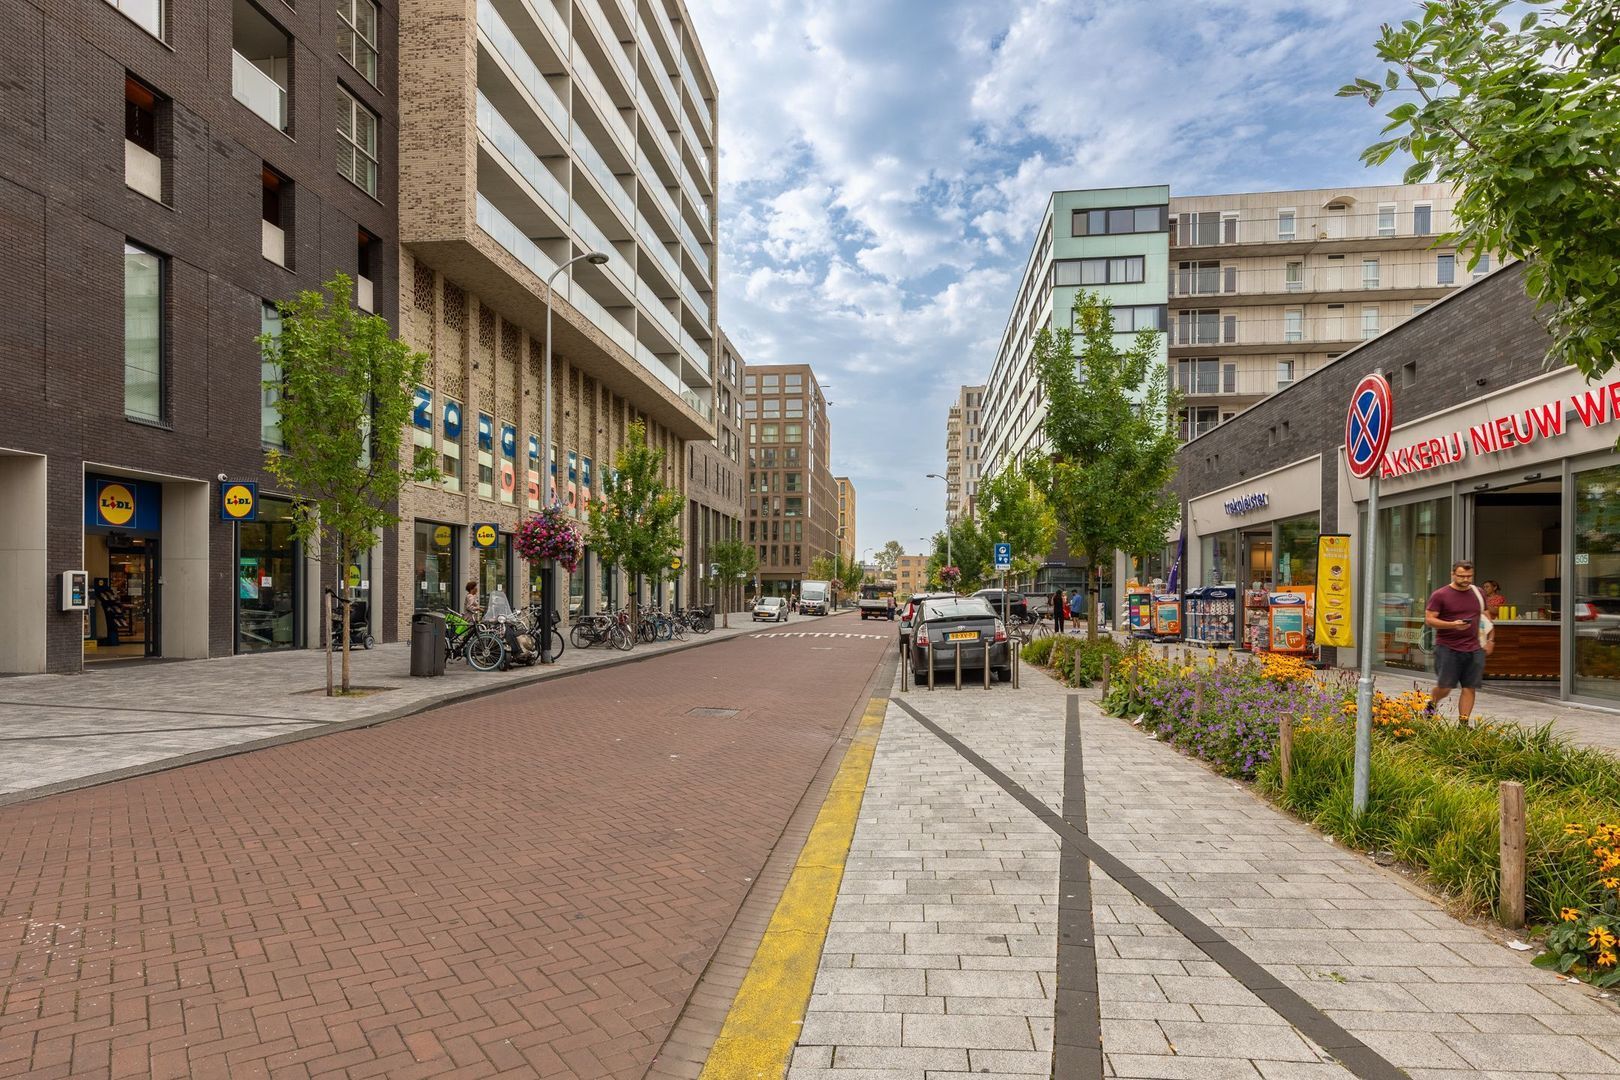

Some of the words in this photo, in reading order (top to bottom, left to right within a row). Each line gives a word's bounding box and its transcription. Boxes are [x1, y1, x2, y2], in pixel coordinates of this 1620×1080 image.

[1380, 432, 1464, 480] AKKERIJ
[1469, 400, 1563, 457] NIEUW
[1224, 492, 1266, 515] trekpleister
